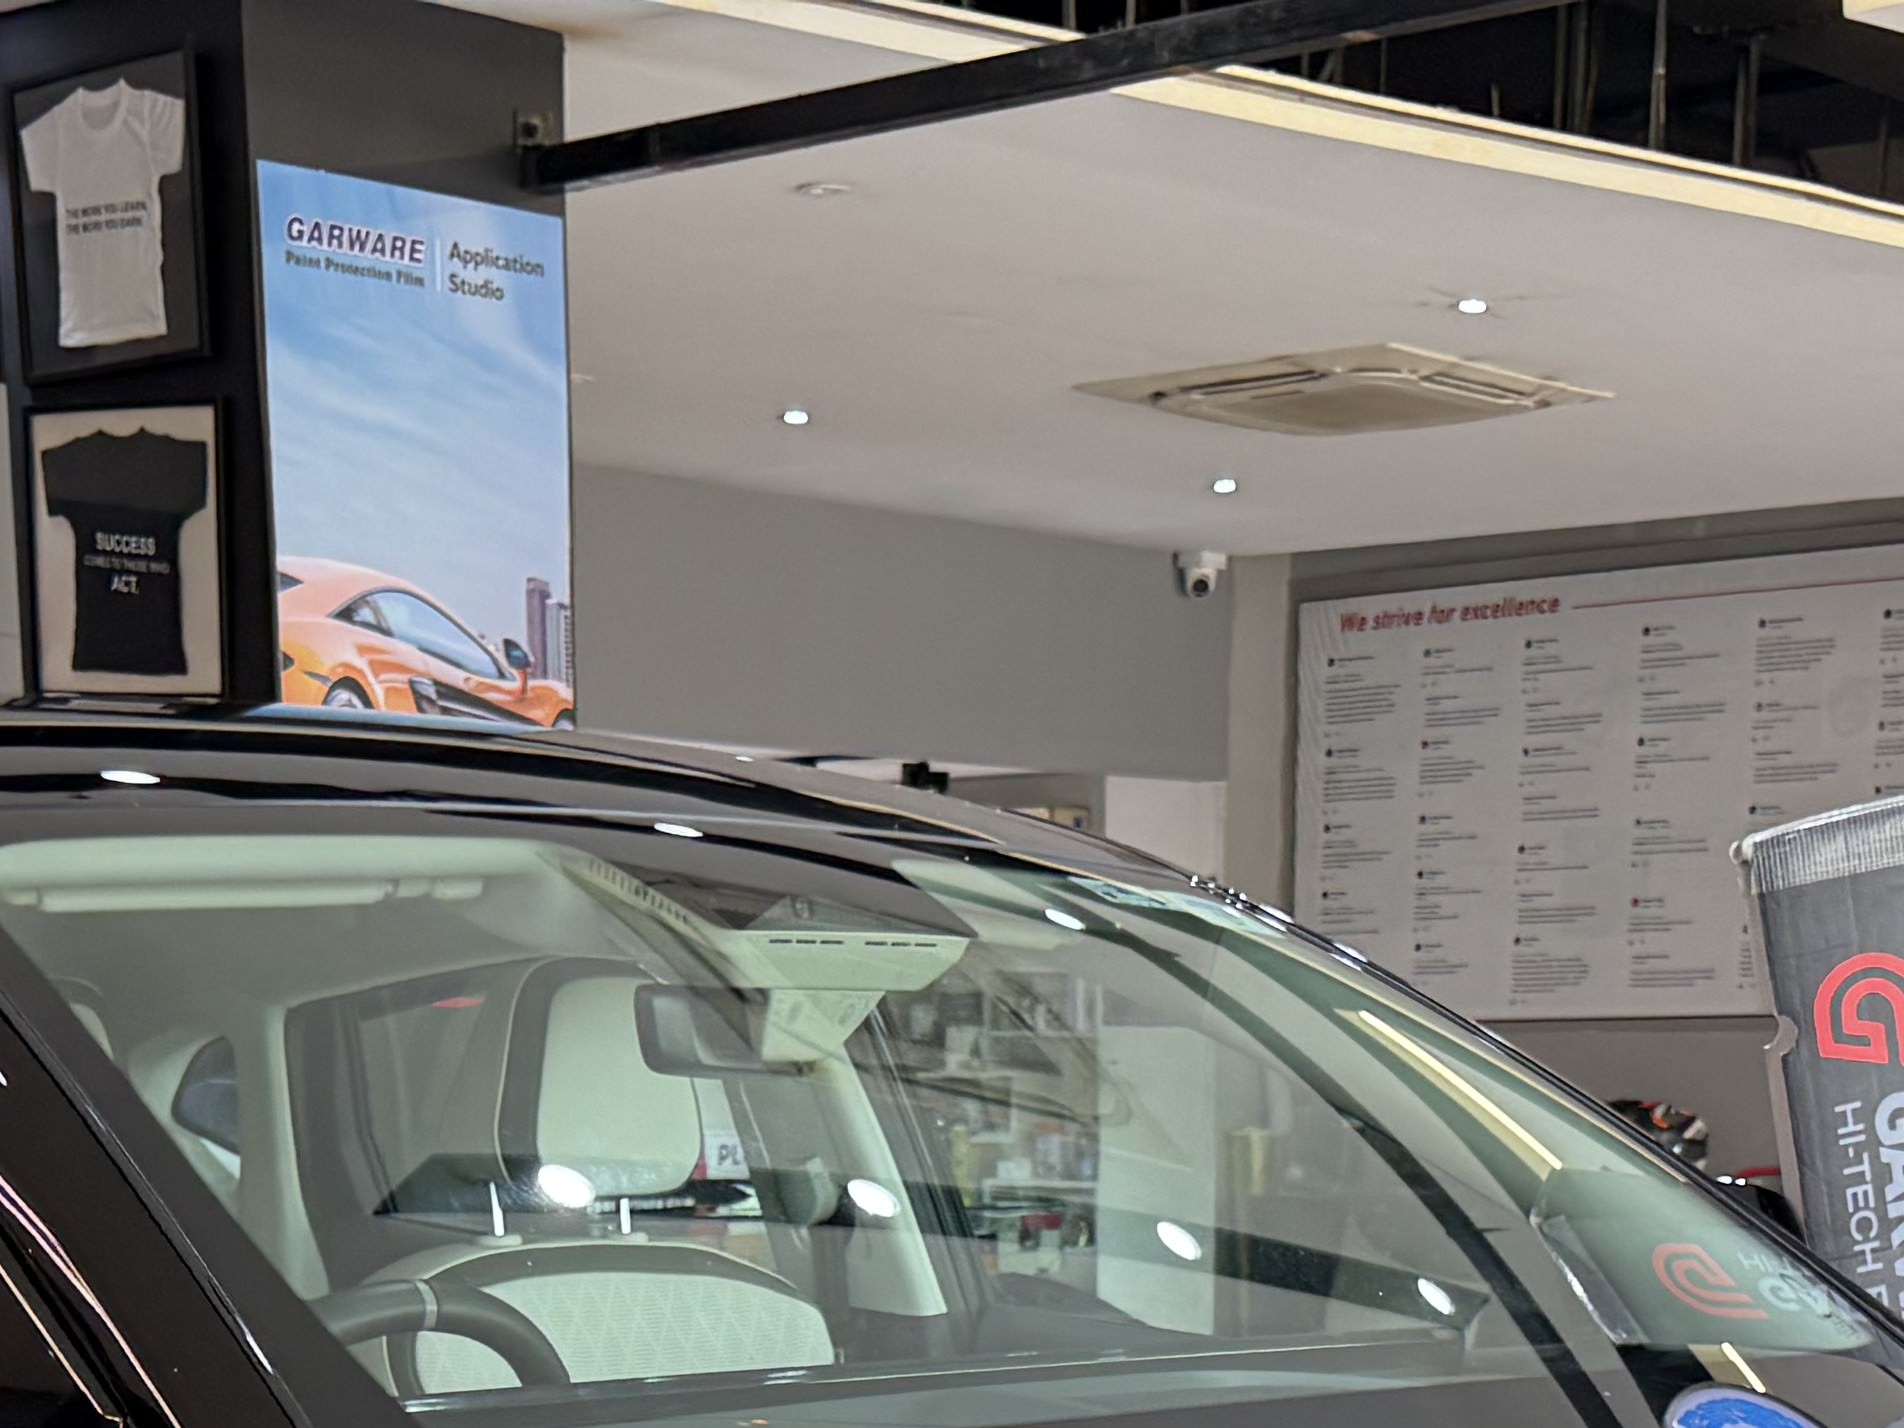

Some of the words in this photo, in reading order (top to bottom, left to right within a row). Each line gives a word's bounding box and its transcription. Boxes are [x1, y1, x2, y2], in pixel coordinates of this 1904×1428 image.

[285, 215, 426, 265] GARWARE
[448, 241, 546, 278] Application
[284, 249, 321, 270] Paint
[324, 256, 393, 282] Protection
[395, 269, 426, 288] Film
[448, 273, 505, 301] Studio
[95, 531, 156, 556] SUCCESS
[1341, 612, 1368, 633] We
[1371, 608, 1424, 631] strive
[1427, 602, 1457, 624] for
[1460, 596, 1561, 622] excellence
[1834, 1101, 1884, 1274] HI-TECH
